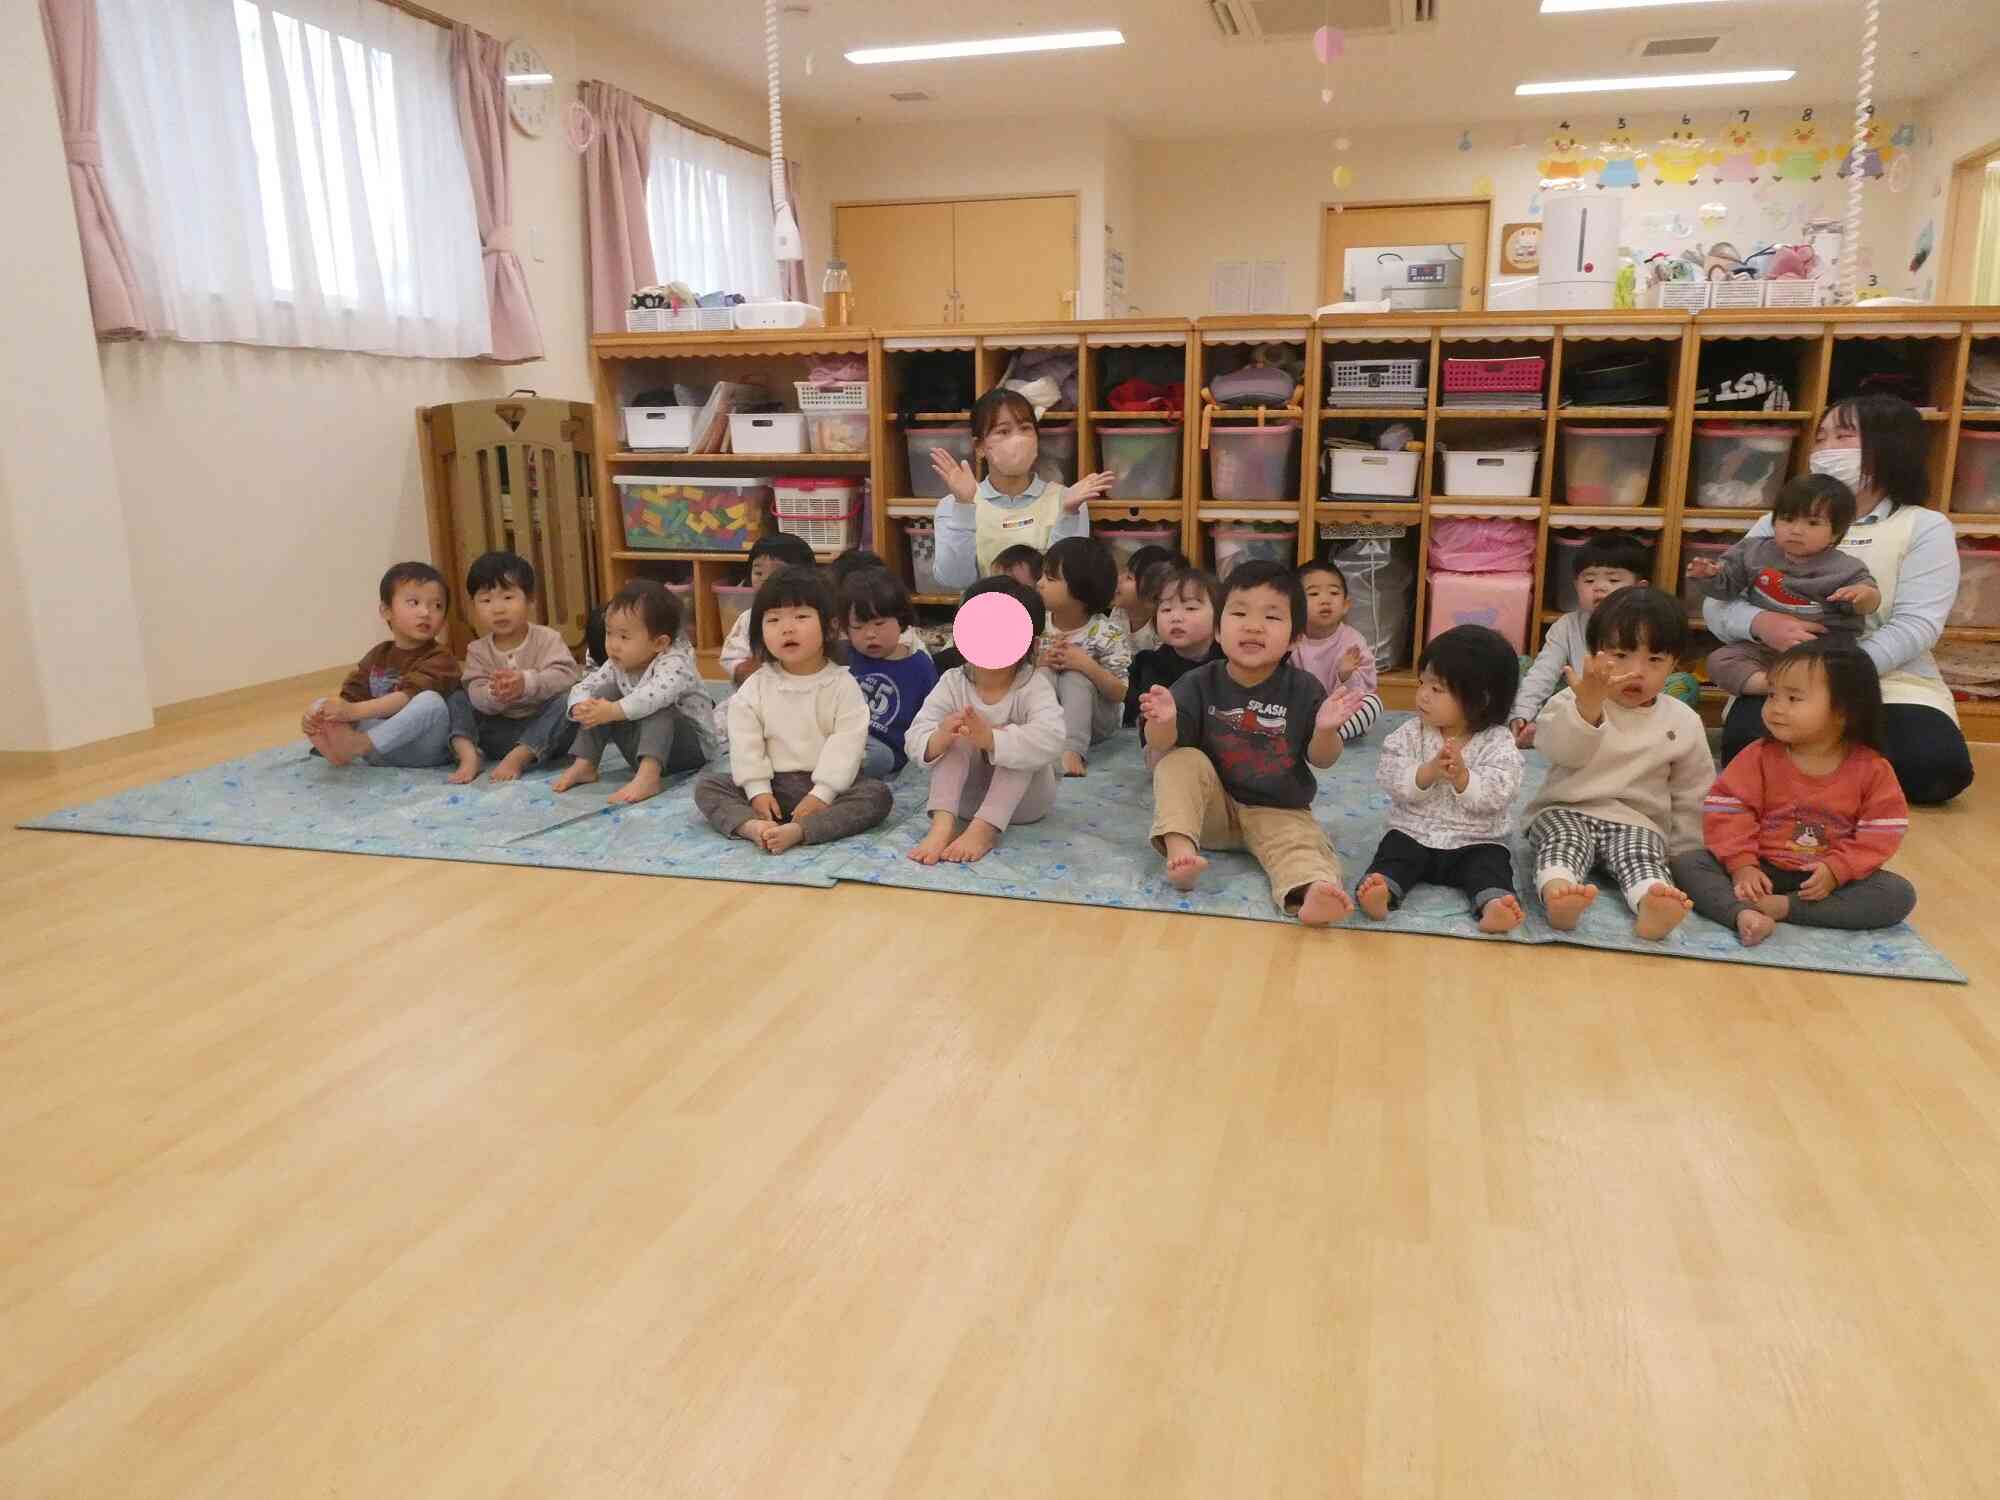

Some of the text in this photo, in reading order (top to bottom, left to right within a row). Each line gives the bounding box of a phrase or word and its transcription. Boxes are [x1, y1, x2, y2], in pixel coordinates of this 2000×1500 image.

[1682, 113, 1691, 125] 6
[1738, 109, 1750, 122] 7
[1802, 108, 1813, 121] 8
[1559, 120, 1571, 131] 4
[1868, 274, 1878, 287] 3
[1247, 699, 1288, 717] SPLASH
